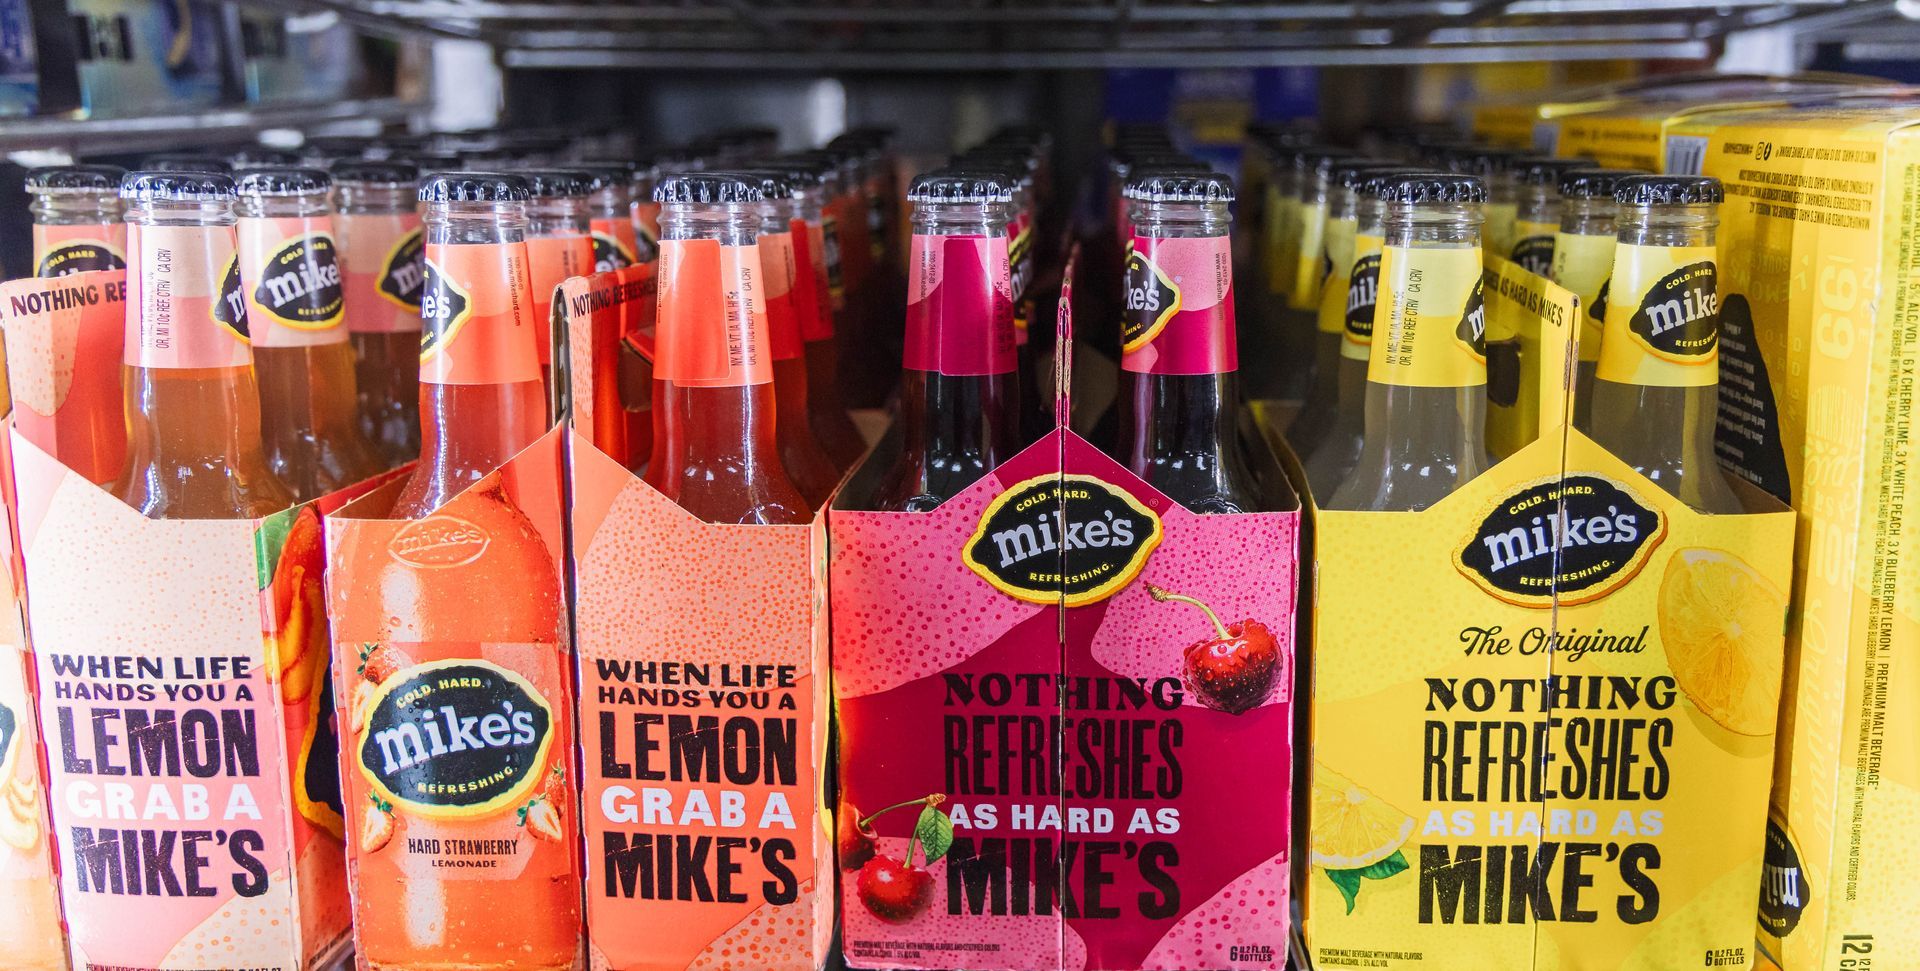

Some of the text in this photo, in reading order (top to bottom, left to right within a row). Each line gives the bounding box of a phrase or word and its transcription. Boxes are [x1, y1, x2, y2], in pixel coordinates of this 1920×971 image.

[158, 248, 171, 262] CRV
[158, 264, 170, 274] CA
[157, 279, 170, 297] CTRV
[741, 268, 751, 280] CRV
[1003, 272, 1009, 282] CA
[1408, 284, 1421, 292] CA
[1409, 269, 1423, 282] CRV
[1666, 274, 1692, 290] COLD.
[10, 284, 100, 318] NOTHING
[507, 257, 521, 327] www.mikeshard.com
[572, 288, 610, 318] NOTHING
[1405, 298, 1418, 315] CTRV
[1404, 317, 1416, 330] REF.
[1528, 291, 1538, 313] AS
[1538, 297, 1563, 327] MIKE'S
[1904, 302, 1918, 345] ALC/VOL
[1401, 345, 1412, 353] MI
[1899, 378, 1912, 418] CHERRY
[1892, 470, 1906, 500] WHITE
[1016, 488, 1091, 512] COLD. HARD.
[1509, 497, 1546, 516] COLD.
[992, 509, 1134, 569] mike's
[1484, 505, 1638, 572] mike's
[1029, 562, 1114, 584] REFRESHING.
[1520, 559, 1615, 586] REFRESHING.
[1882, 559, 1897, 614] BLUEBERRY
[1460, 625, 1650, 662] The Original
[1880, 618, 1892, 650] LEMON
[50, 654, 252, 680] WHEN LIFE
[596, 659, 797, 688] WHEN LIFE
[55, 681, 254, 702] HANDS YOU A
[396, 676, 486, 710] COLD. HARD.
[598, 686, 798, 710] HANDS YOU A
[942, 672, 1184, 712] NOTHING
[1424, 674, 1678, 713] NOTHING
[1875, 664, 1889, 708] PREMIUM
[375, 700, 536, 775] mike's
[1872, 712, 1885, 736] MALT
[57, 706, 260, 778] LEMON
[599, 710, 798, 786] LEMON
[943, 714, 1184, 800] REFRESHES
[1422, 716, 1673, 803] REFRESHES
[417, 766, 518, 794] REFRESHING.
[65, 780, 263, 821] GRAB A
[600, 785, 798, 830] GRAB A
[948, 804, 1180, 834] AS HARD AS
[1422, 808, 1664, 838] AS HARD AS
[408, 838, 518, 856] HARD STRAWBERRY
[71, 826, 269, 898] MIKE'S
[431, 860, 497, 868] LEMONADE
[602, 831, 798, 906] MIKE'S
[946, 837, 1181, 921] MIKE'S
[1418, 842, 1661, 926] MIKE'S
[1229, 946, 1238, 962] 6
[1239, 954, 1272, 962] BOTTLES
[1320, 948, 1340, 956] PREMIUM
[1340, 949, 1352, 957] MALT
[1352, 950, 1373, 958] BEVERAGE
[1385, 952, 1403, 960] NATURAL
[1404, 952, 1423, 960] FLAVORS
[1705, 950, 1712, 966] 6
[1842, 934, 1874, 954] 12
[1340, 958, 1359, 966] ALCOHOL
[1714, 956, 1745, 966] BOTTLES
